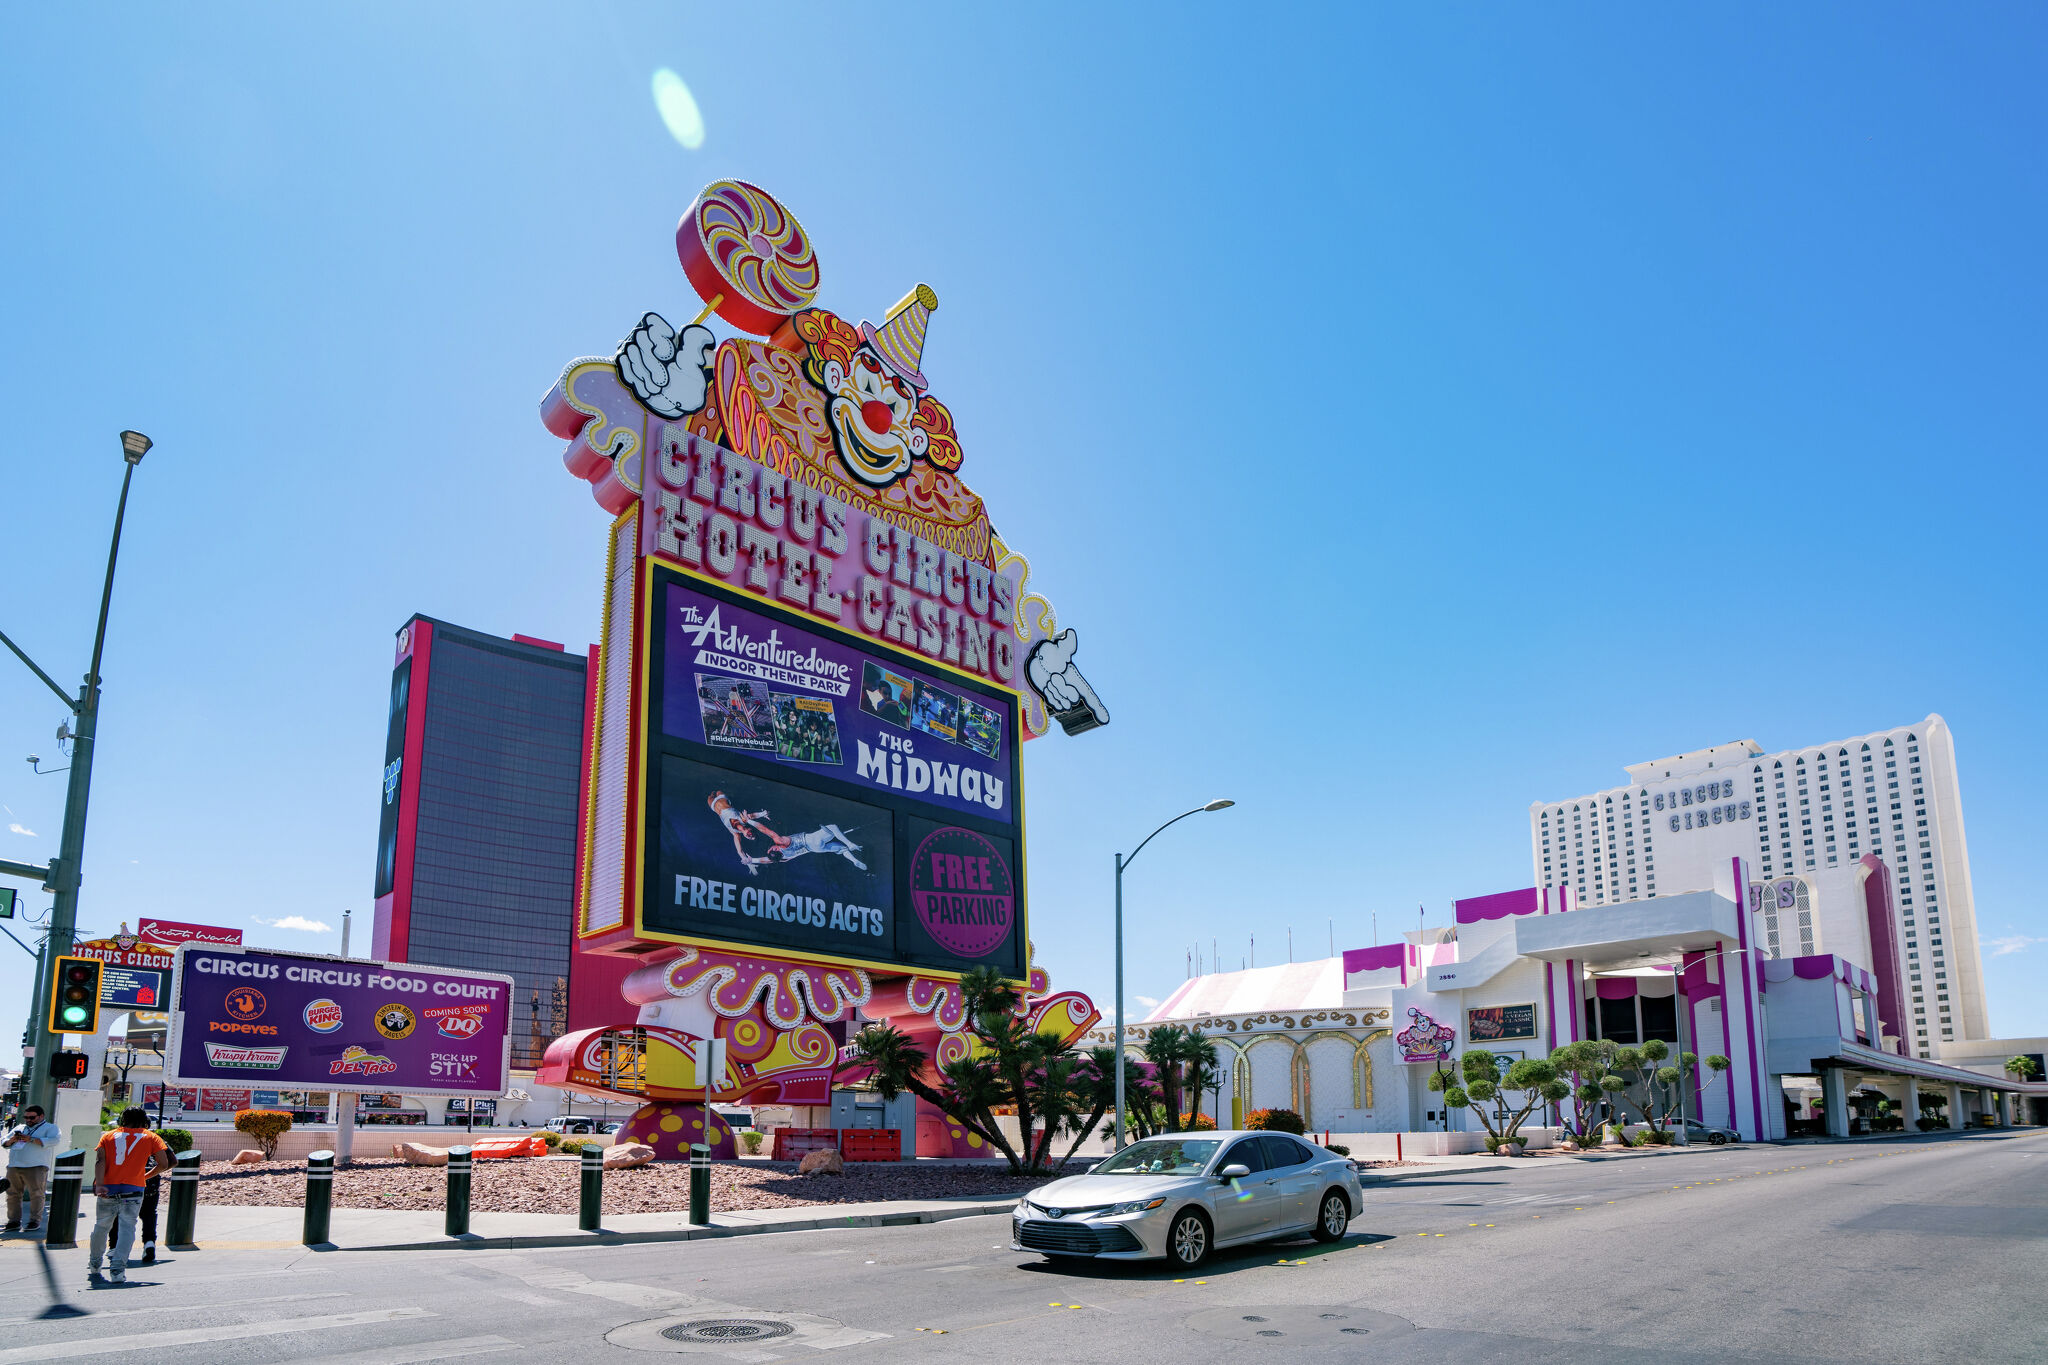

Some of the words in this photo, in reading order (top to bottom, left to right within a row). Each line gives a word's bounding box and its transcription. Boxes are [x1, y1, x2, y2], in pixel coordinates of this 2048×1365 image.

[657, 423, 848, 555] CIRCUS
[866, 517, 1013, 626] CIRCUS
[656, 489, 842, 618] HOTEL
[860, 574, 1014, 681] CASINO
[680, 606, 704, 624] The
[681, 604, 851, 682] Adventuredome
[704, 652, 756, 674] INDOOR
[760, 666, 806, 686] THEME
[810, 678, 842, 694] PARK
[1654, 780, 1734, 811] CIRCUS
[1670, 801, 1750, 832] CIRCUS
[931, 852, 992, 891] FREE
[674, 874, 736, 914] FREE
[740, 886, 826, 928] CIRCUS
[829, 902, 884, 936] ACTS
[926, 895, 1006, 926] PARKING
[196, 931, 240, 942] World
[195, 957, 280, 980] CIRCUS
[286, 966, 362, 987] CIRCUS
[368, 974, 428, 993] FOOD
[432, 982, 500, 1000] COURT
[308, 1006, 340, 1016] BURGER
[308, 1012, 342, 1025] KING
[377, 1004, 402, 1018] EINSTEIN
[424, 1006, 461, 1018] COMING
[462, 1004, 488, 1014] SOON
[445, 1017, 476, 1034] DQ
[212, 1049, 247, 1062] Krispy
[246, 1049, 280, 1062] Kreme
[430, 1052, 458, 1062] PICK
[844, 1045, 870, 1058] CIRC
[430, 1061, 478, 1078] STIX
